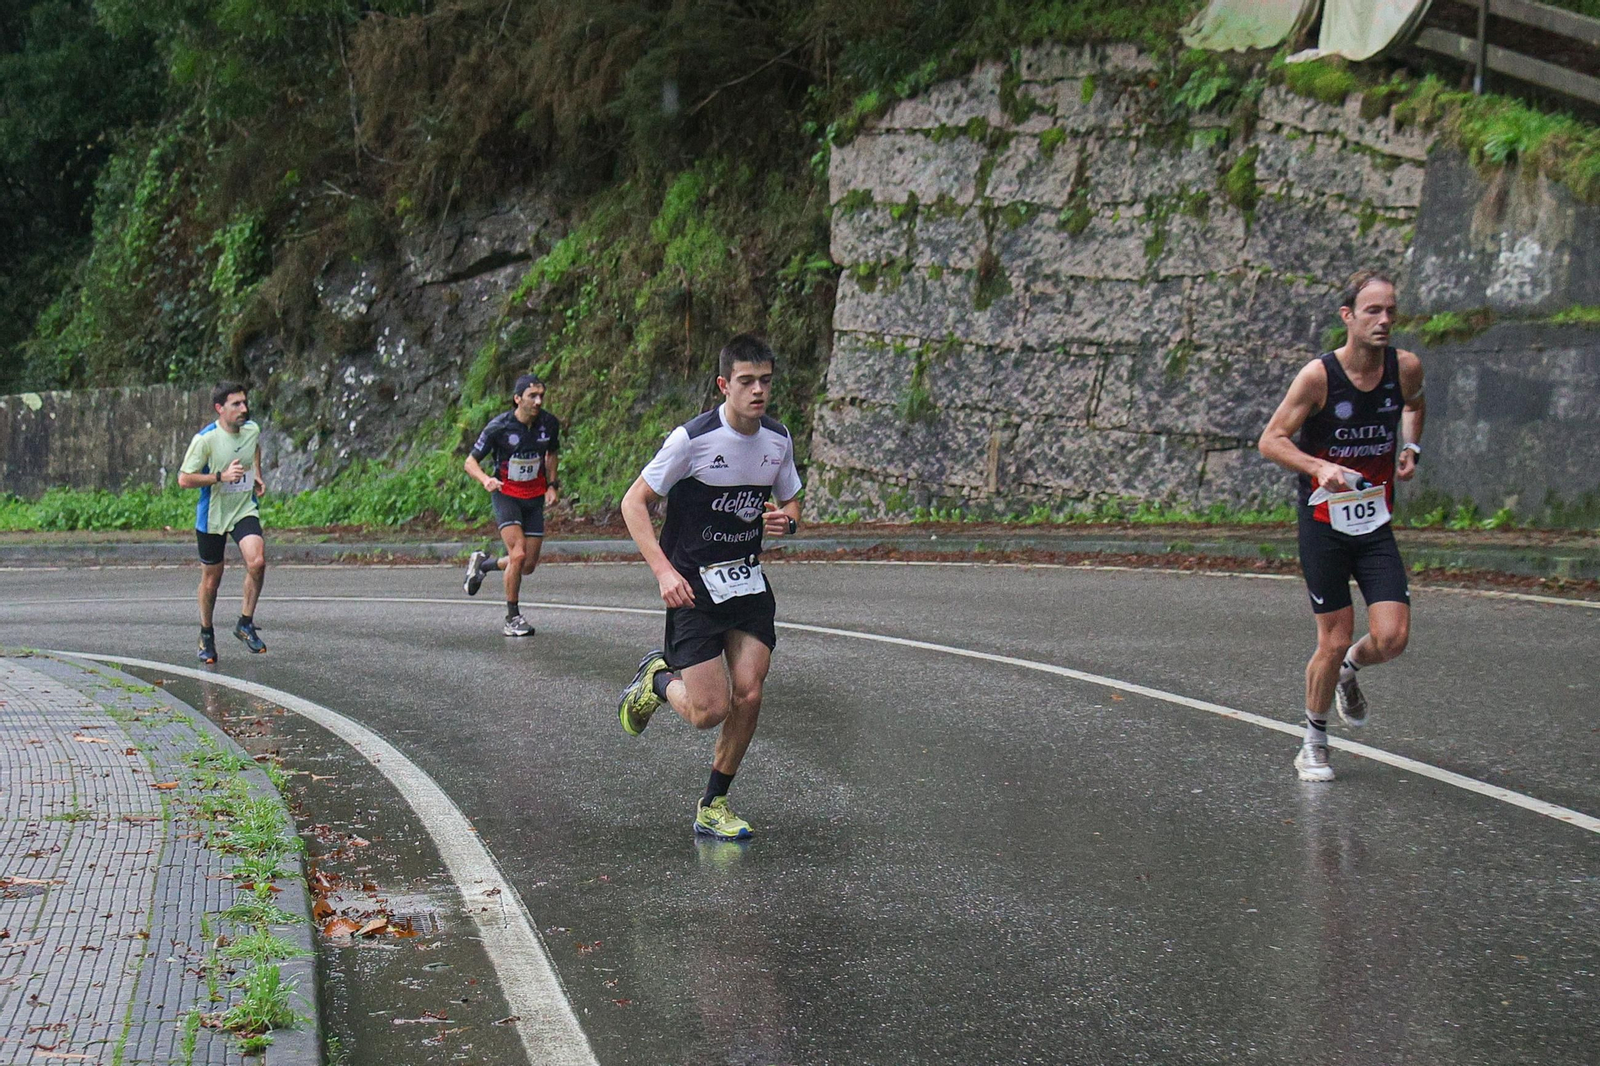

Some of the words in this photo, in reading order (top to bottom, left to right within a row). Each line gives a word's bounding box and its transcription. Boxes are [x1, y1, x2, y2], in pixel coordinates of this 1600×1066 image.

[1334, 425, 1387, 440] GMTA
[519, 465, 534, 474] 58
[1342, 501, 1376, 521] 105
[714, 565, 752, 584] 169
